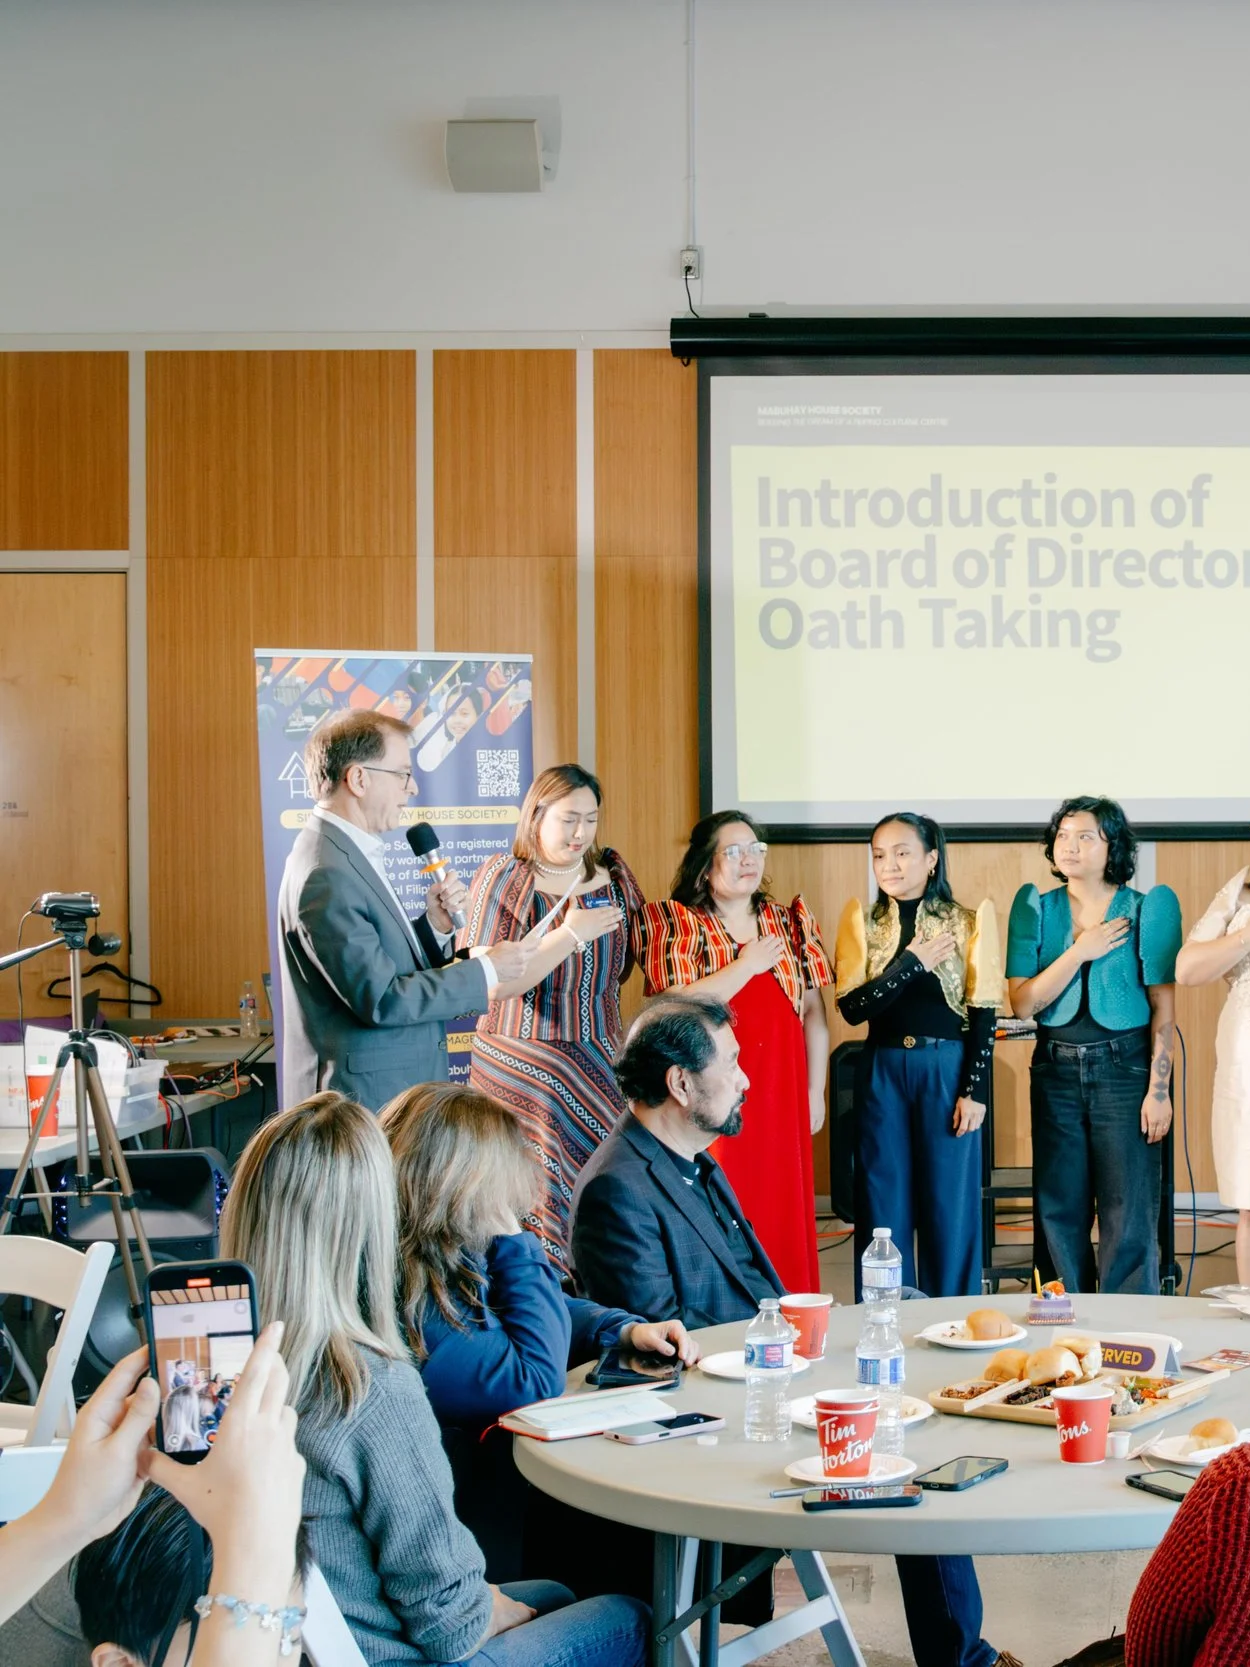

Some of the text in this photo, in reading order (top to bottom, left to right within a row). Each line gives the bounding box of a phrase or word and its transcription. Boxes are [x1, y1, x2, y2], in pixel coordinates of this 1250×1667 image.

[758, 406, 883, 416] MABUHAY HOUSE SOCIETY
[757, 472, 1212, 529] Introduction of
[758, 533, 938, 589] Board
[952, 533, 1016, 589] of
[758, 592, 1123, 664] Oath Taking
[417, 810, 455, 820] HOUSE
[457, 809, 508, 820] SOCIETY?
[456, 838, 509, 851] registered
[398, 868, 410, 880] of
[820, 1416, 857, 1446] Tim
[820, 1435, 875, 1472] Horton
